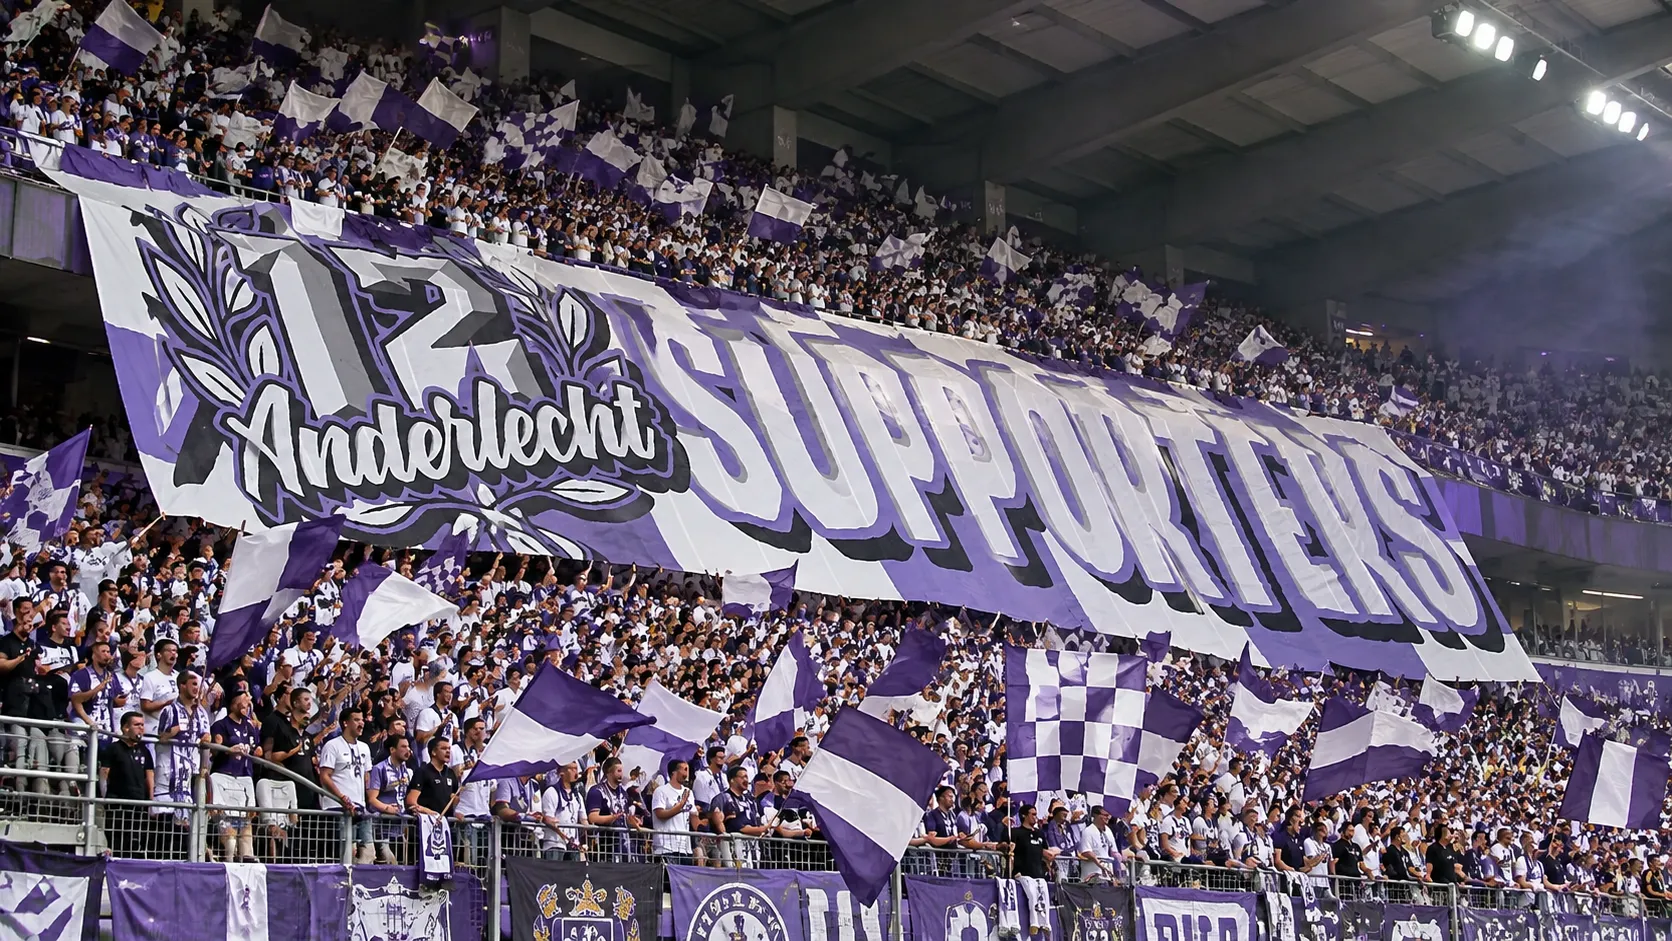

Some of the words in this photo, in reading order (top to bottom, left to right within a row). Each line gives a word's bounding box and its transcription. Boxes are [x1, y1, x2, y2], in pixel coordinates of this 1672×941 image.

[213, 230, 546, 417] 12
[226, 380, 657, 503] Anderlecht
[614, 298, 1484, 634] SUPPORTERS
